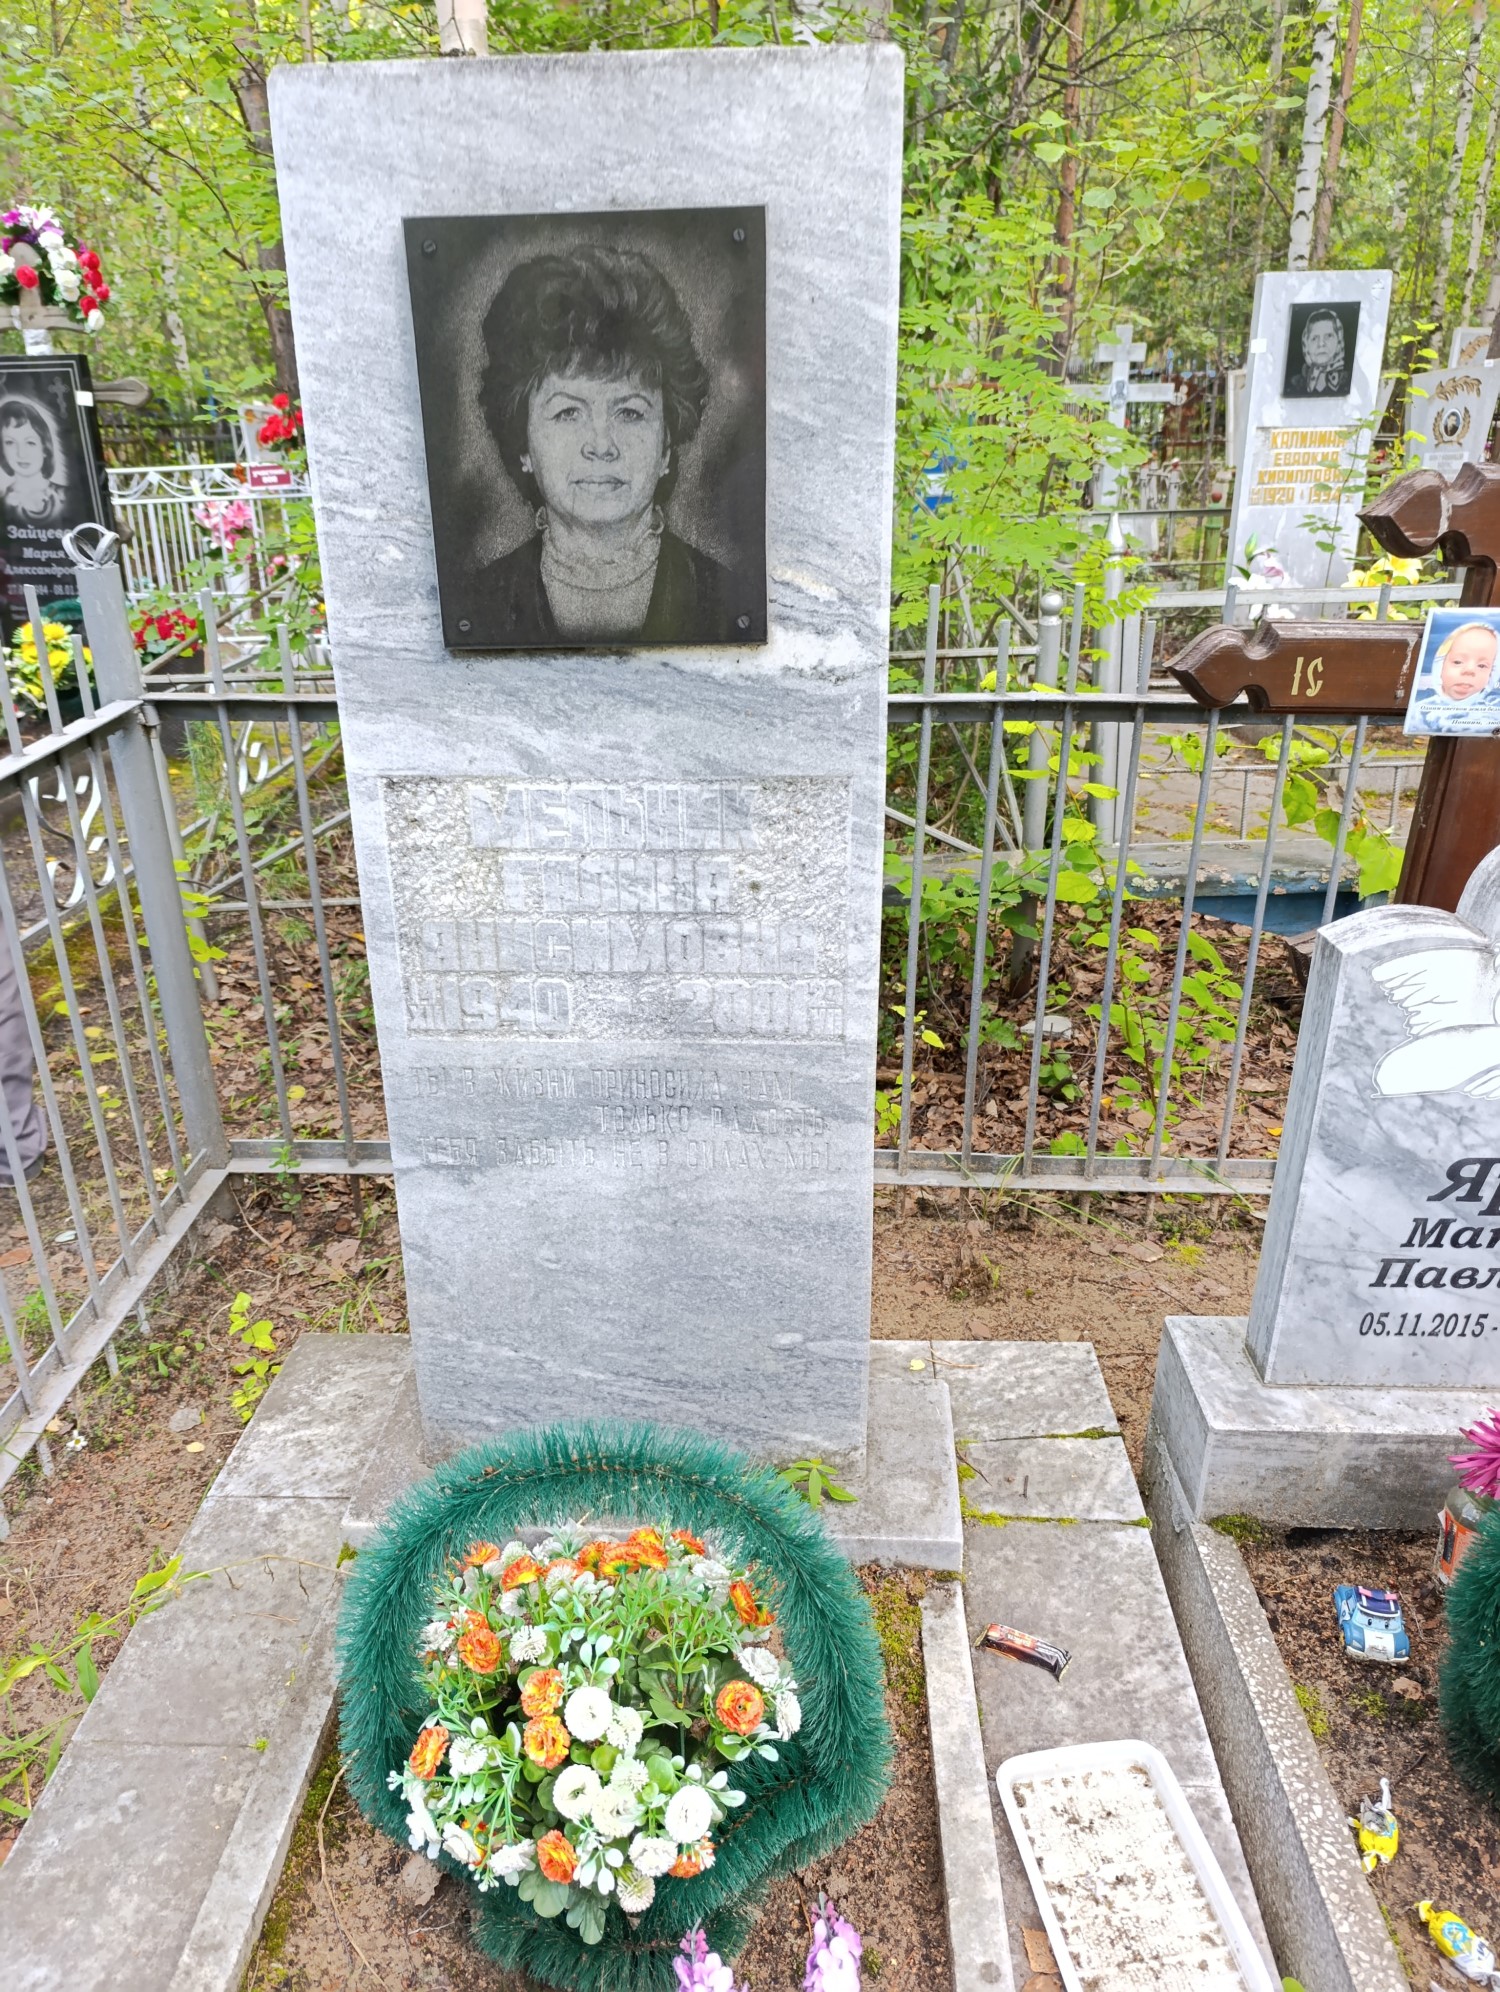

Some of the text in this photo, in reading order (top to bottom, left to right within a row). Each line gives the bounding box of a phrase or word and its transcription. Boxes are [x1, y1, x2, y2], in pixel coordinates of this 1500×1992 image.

[22, 547, 66, 561] Мария
[500, 855, 730, 912] ГАЛИНА
[422, 918, 818, 973] АНИСИМОВНА
[410, 1067, 795, 1102] ТЫ В ЖИЗНИ ПРИНОСИЛА НАМ
[594, 1104, 692, 1134] ТОЛЬКО
[417, 1137, 479, 1167] ТЕБЯ
[496, 1137, 596, 1167] ЗАБЫТЬ
[613, 1138, 643, 1168] НЕ
[657, 1138, 670, 1168] В
[1359, 1311, 1489, 1338] 05.11.2015
